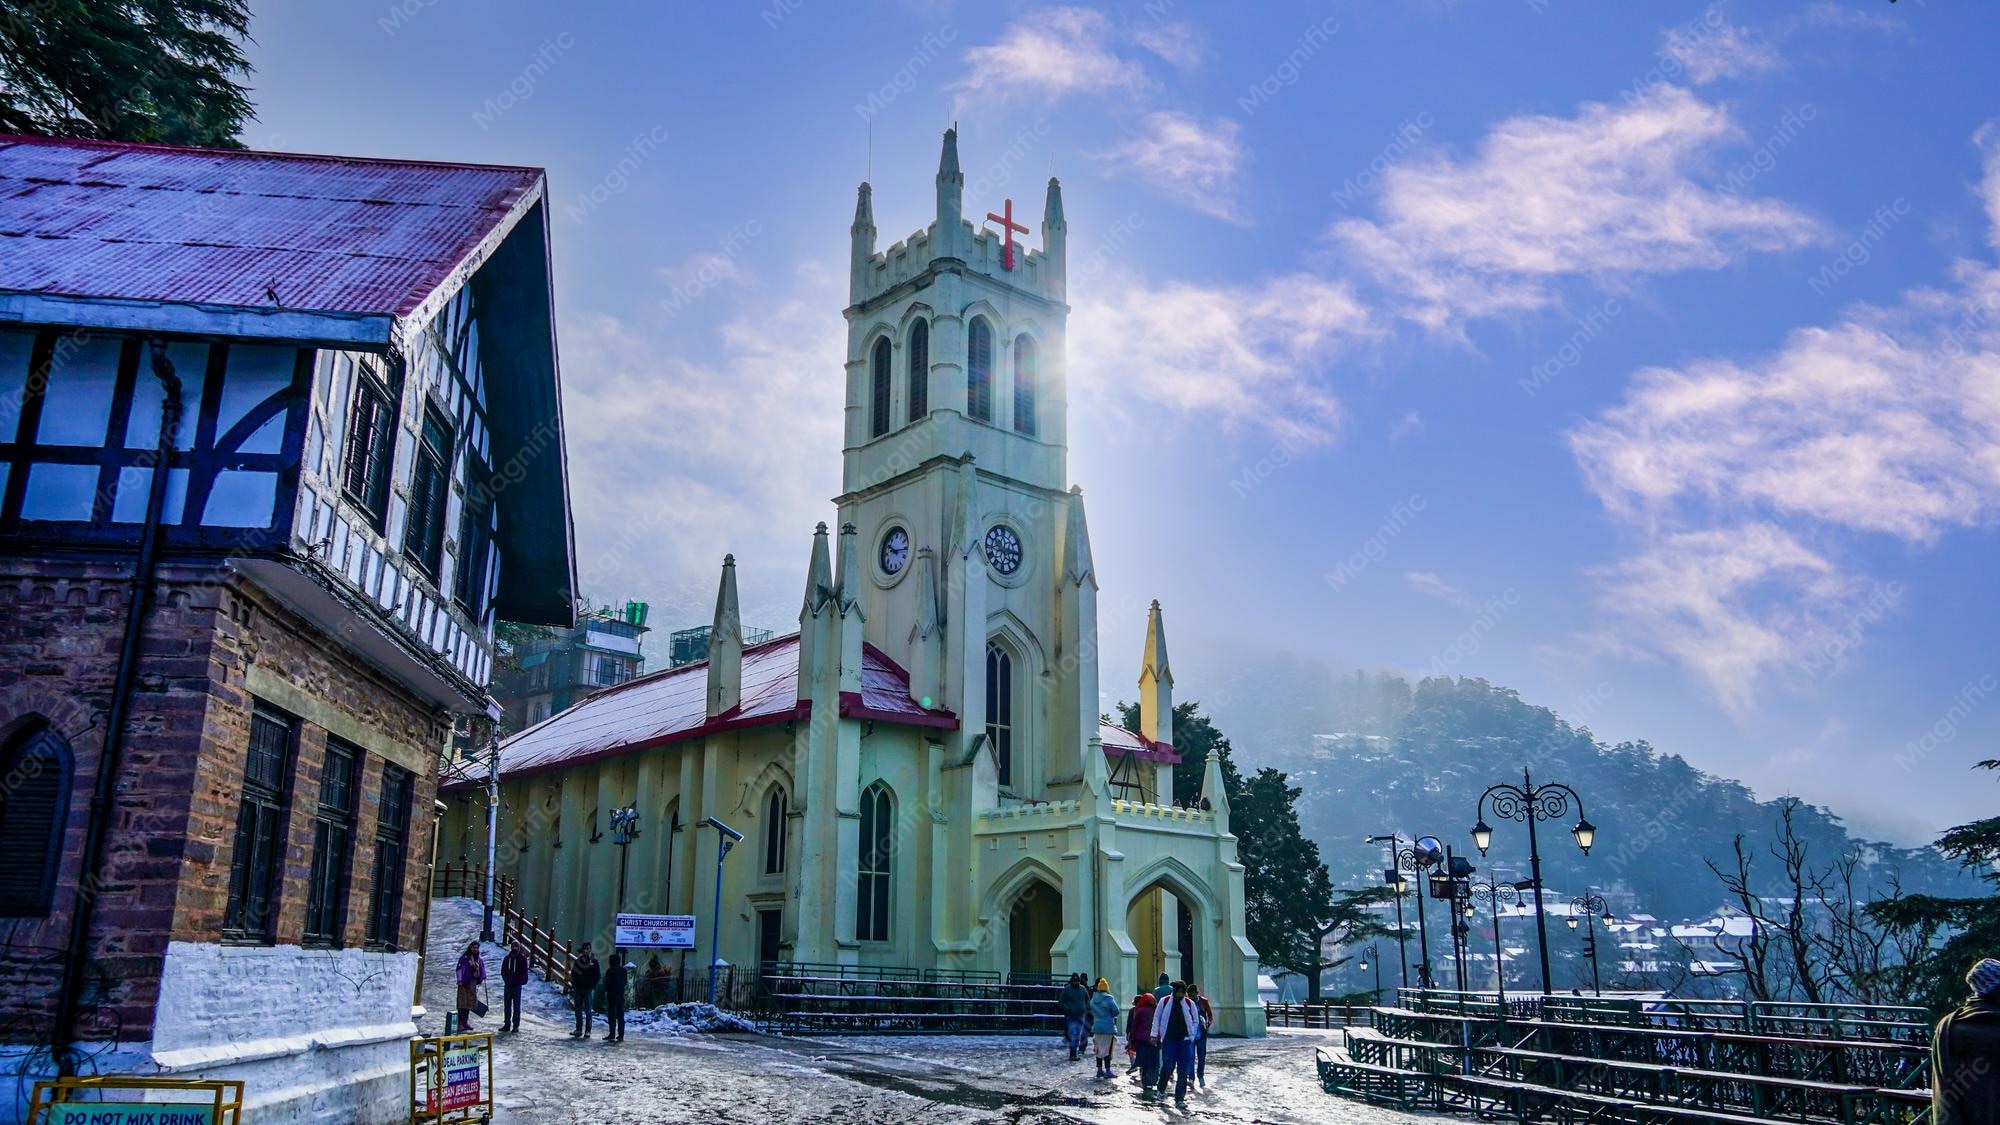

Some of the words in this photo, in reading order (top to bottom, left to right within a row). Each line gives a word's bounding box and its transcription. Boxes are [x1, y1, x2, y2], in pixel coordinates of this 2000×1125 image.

[457, 1053, 478, 1066] PARKING
[448, 1072, 463, 1084] SHIMLA
[463, 1069, 478, 1080] POLICE
[455, 1081, 479, 1096] JEWELLERS
[64, 1112, 87, 1125] DO
[90, 1112, 124, 1125] NOT
[126, 1112, 155, 1125] MIX
[159, 1113, 206, 1125] DRINK
